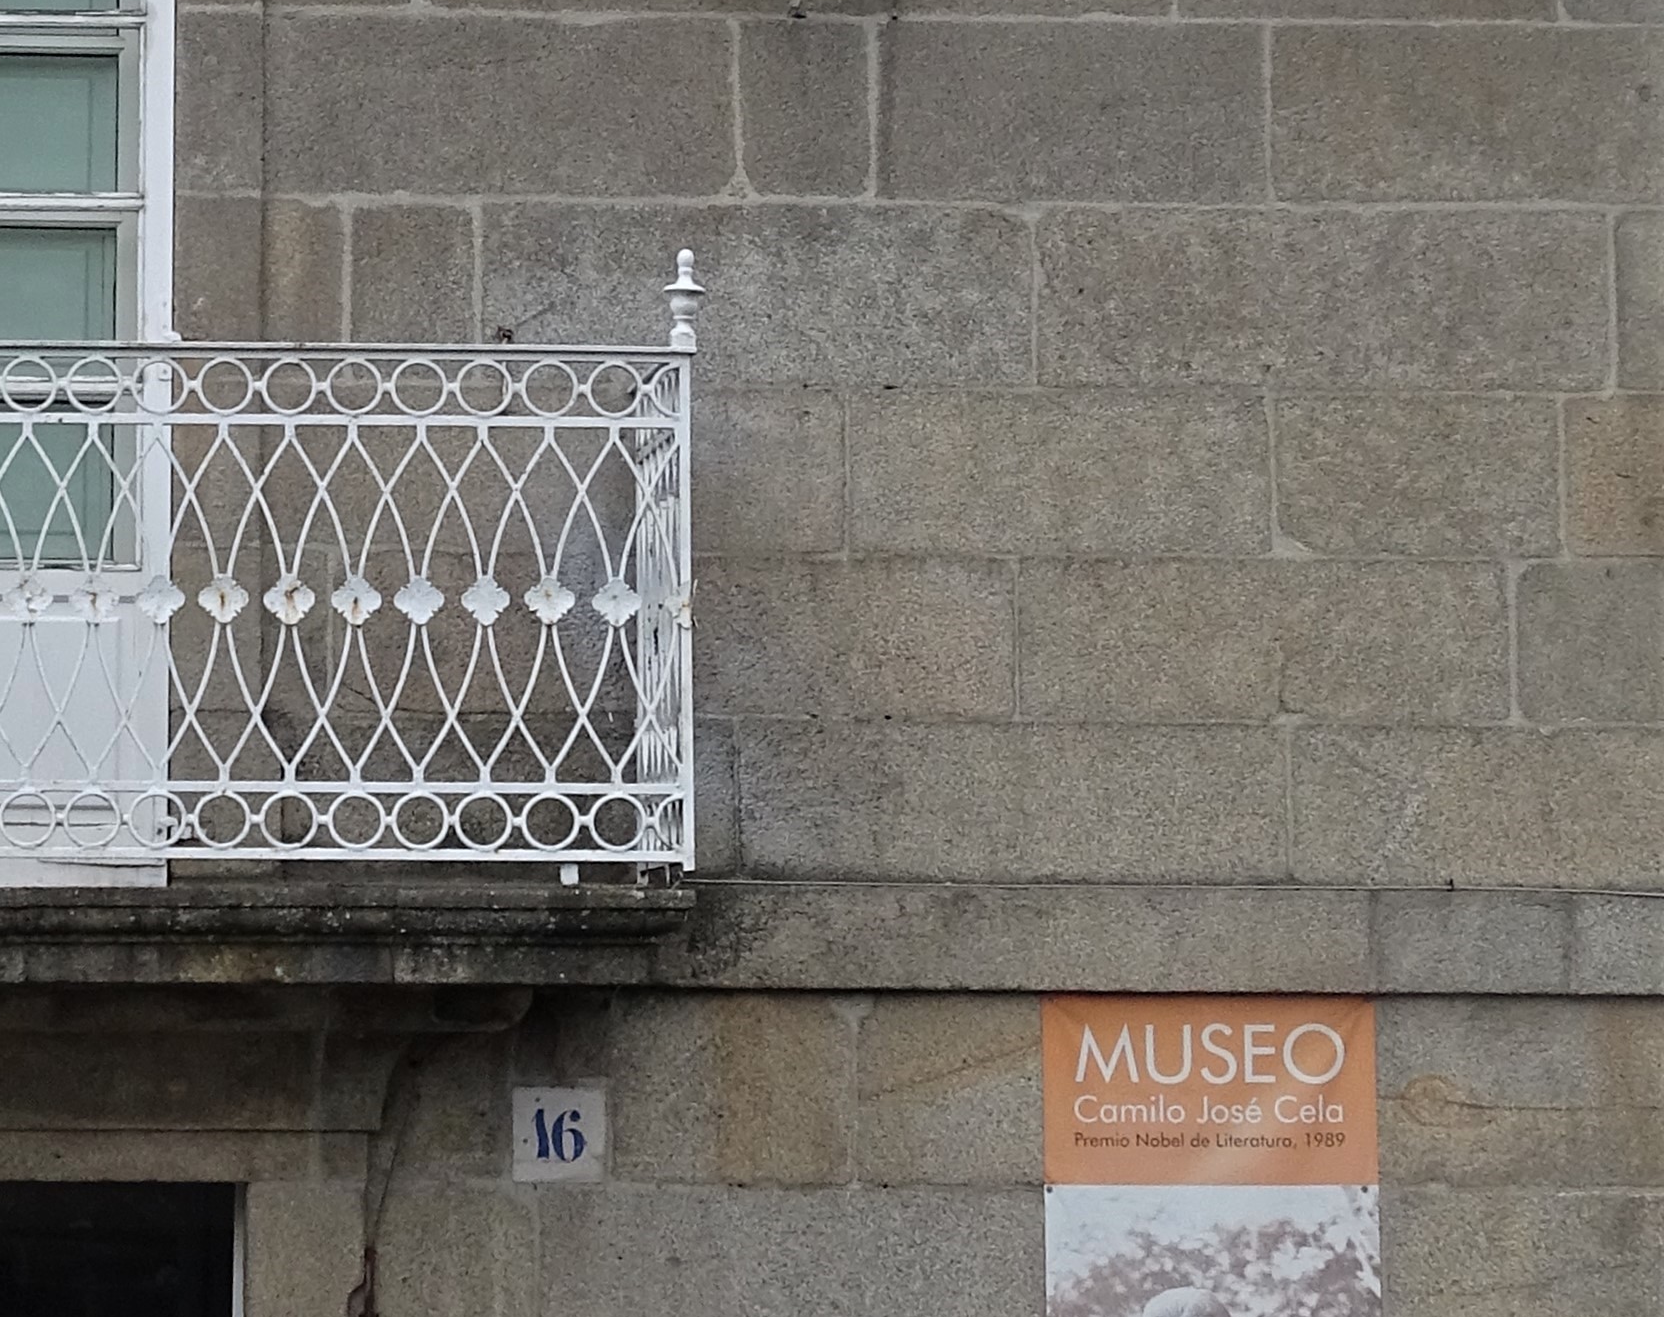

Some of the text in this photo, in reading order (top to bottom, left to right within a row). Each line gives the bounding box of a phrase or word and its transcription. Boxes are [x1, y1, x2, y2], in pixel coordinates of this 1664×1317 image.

[1075, 1022, 1346, 1085] MUSEO
[1073, 1094, 1344, 1125] Camilo José Cela
[532, 1108, 587, 1163] 16
[1074, 1132, 1346, 1150] Premio Nobel de Literatura, 1989
